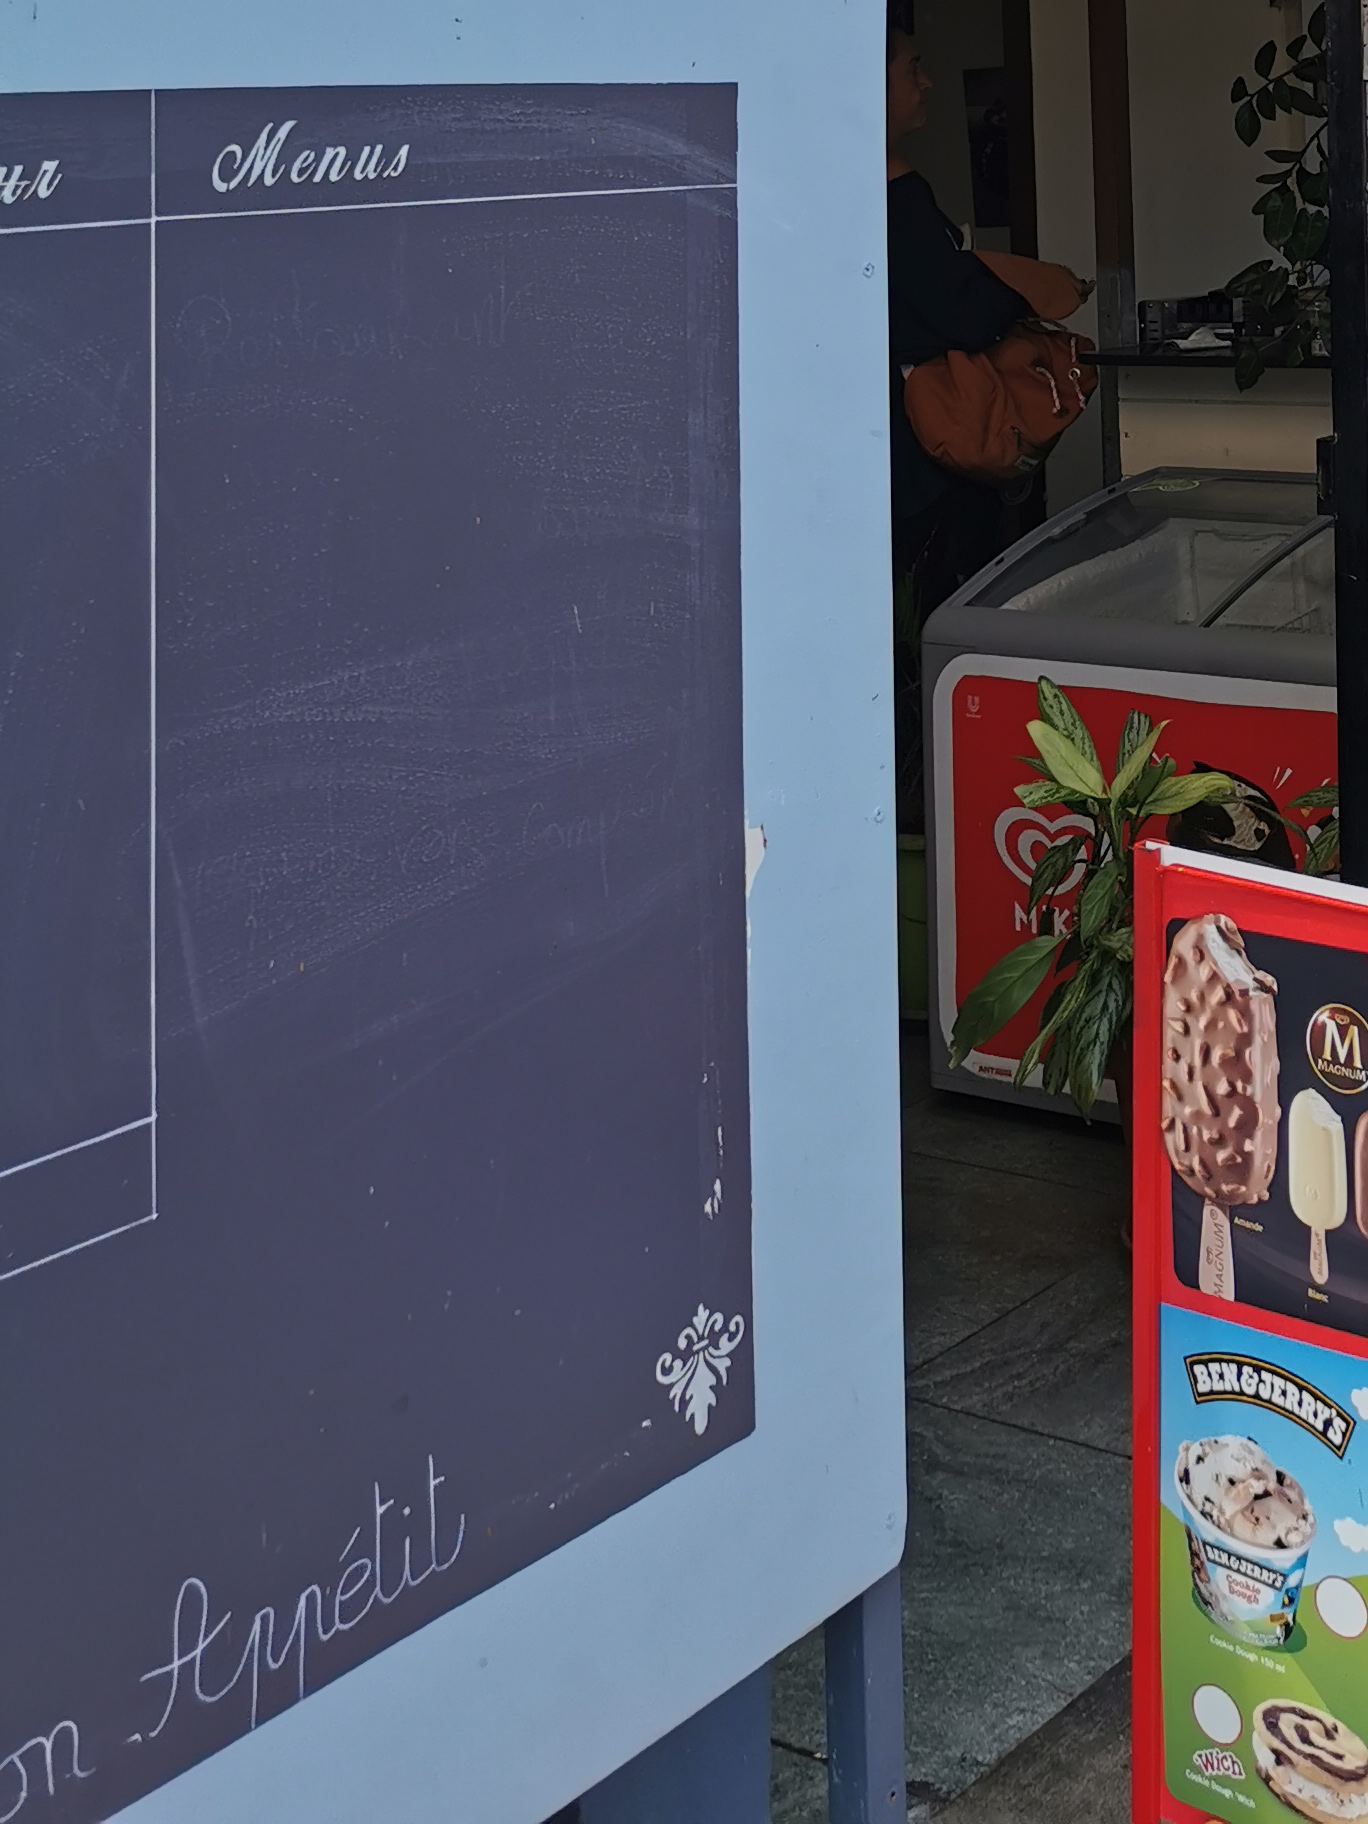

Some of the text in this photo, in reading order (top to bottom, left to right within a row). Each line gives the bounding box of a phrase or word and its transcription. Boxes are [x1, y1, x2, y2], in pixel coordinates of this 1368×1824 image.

[212, 120, 410, 194] Menus
[1317, 1057, 1368, 1082] MAGNUM
[138, 1453, 466, 1739] Appétit
[1225, 1573, 1262, 1596] Cookie
[1227, 1582, 1260, 1606] Dough
